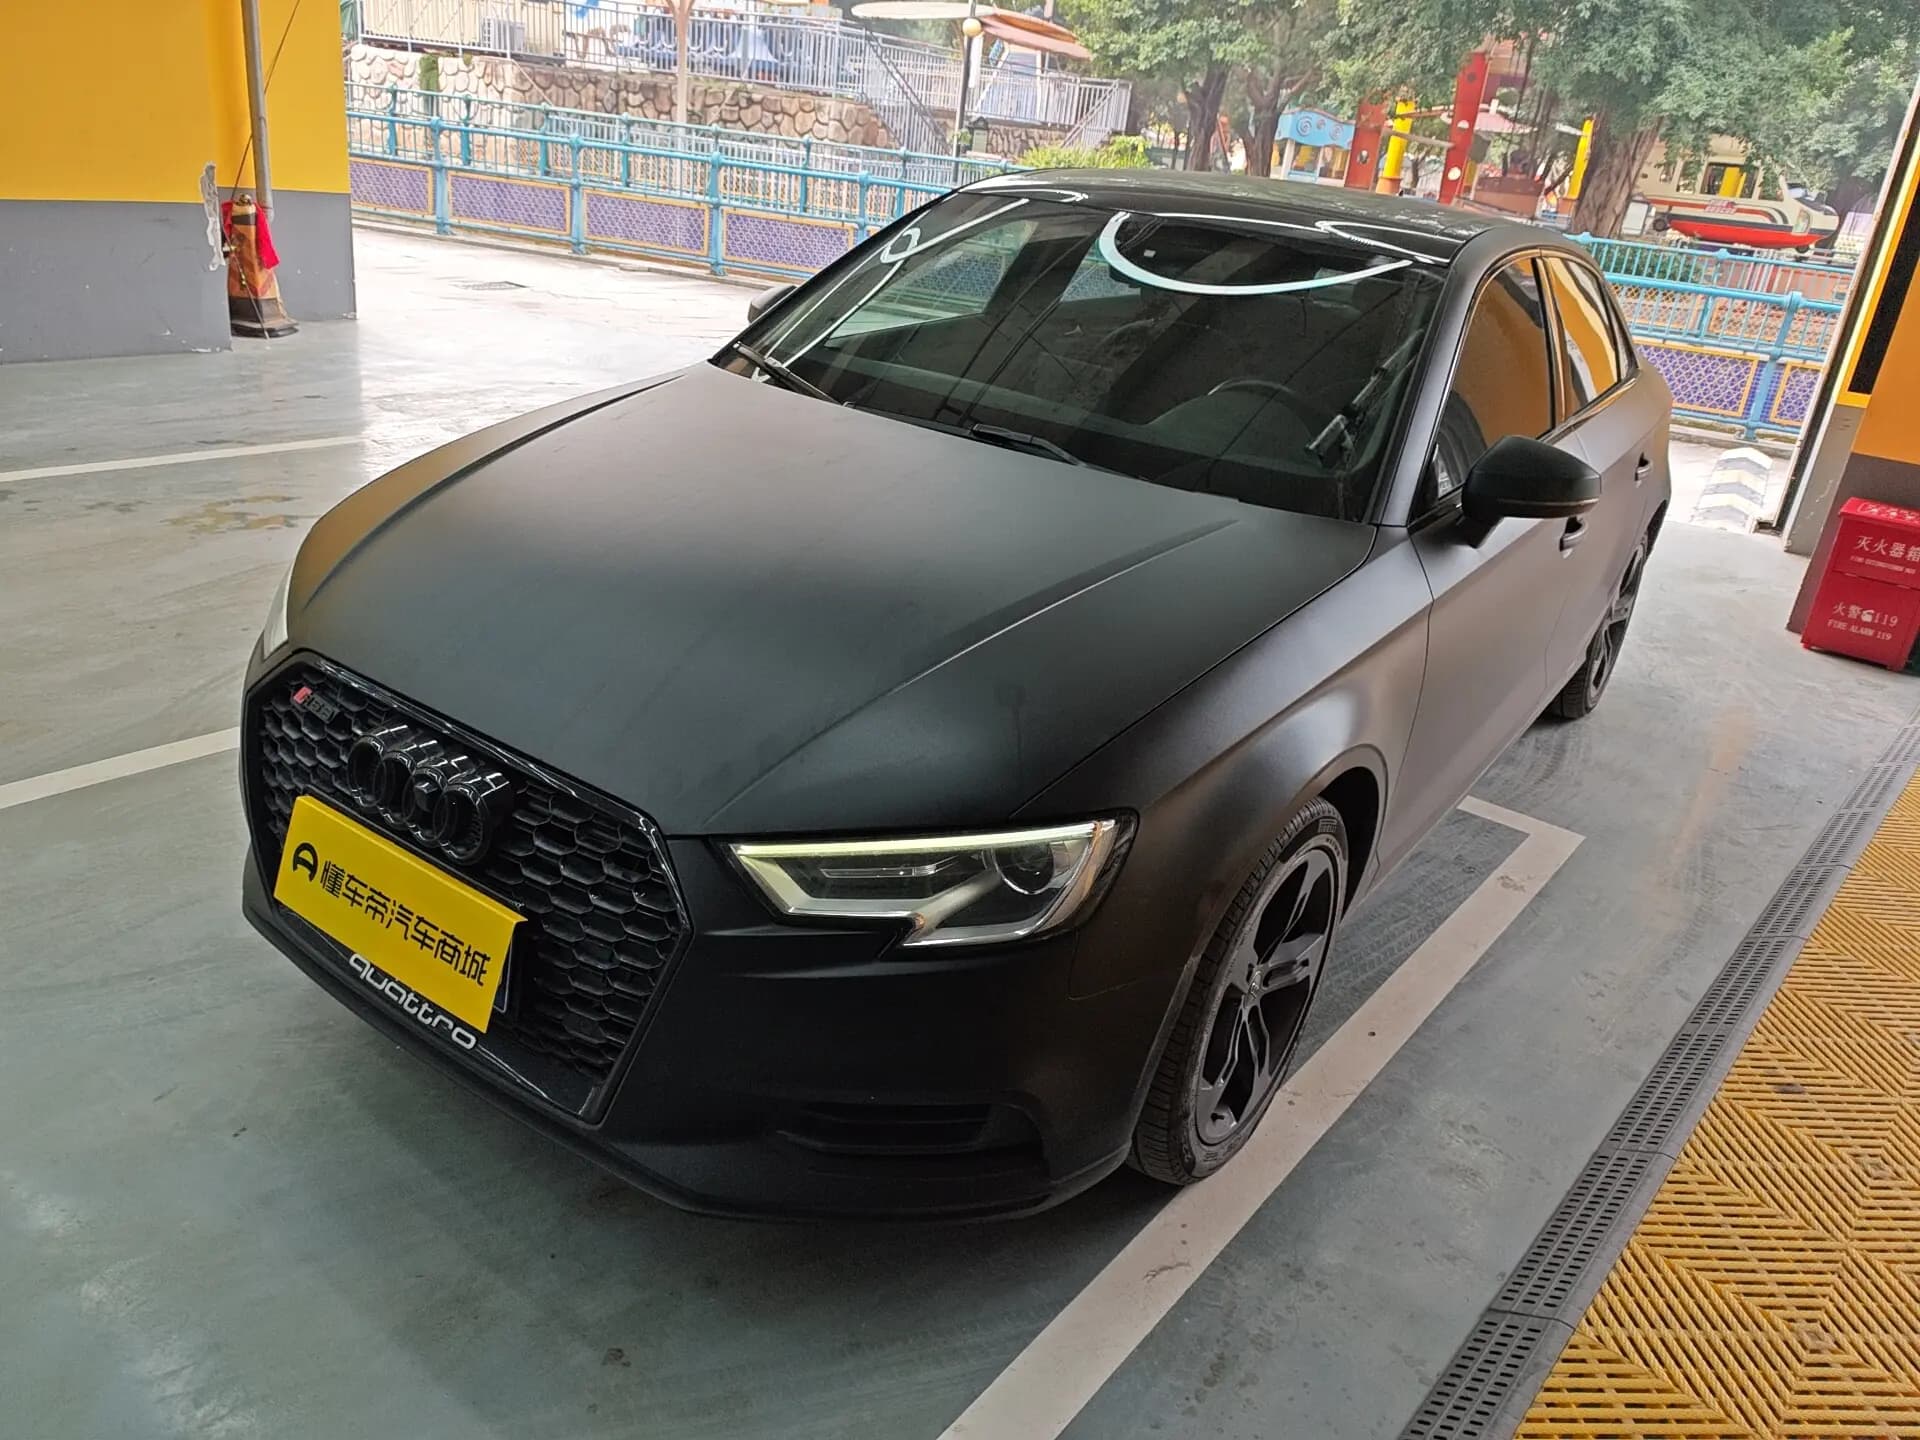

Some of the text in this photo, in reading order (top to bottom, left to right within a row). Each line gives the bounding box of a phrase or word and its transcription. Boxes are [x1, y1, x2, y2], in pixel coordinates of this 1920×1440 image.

[1854, 535, 1920, 562] 灭火器箱
[1827, 619, 1892, 640] FIRE ALARM 119
[1874, 612, 1898, 627] 119
[320, 860, 491, 987] 懂车帝汽车商城
[349, 953, 477, 1050] quattro
